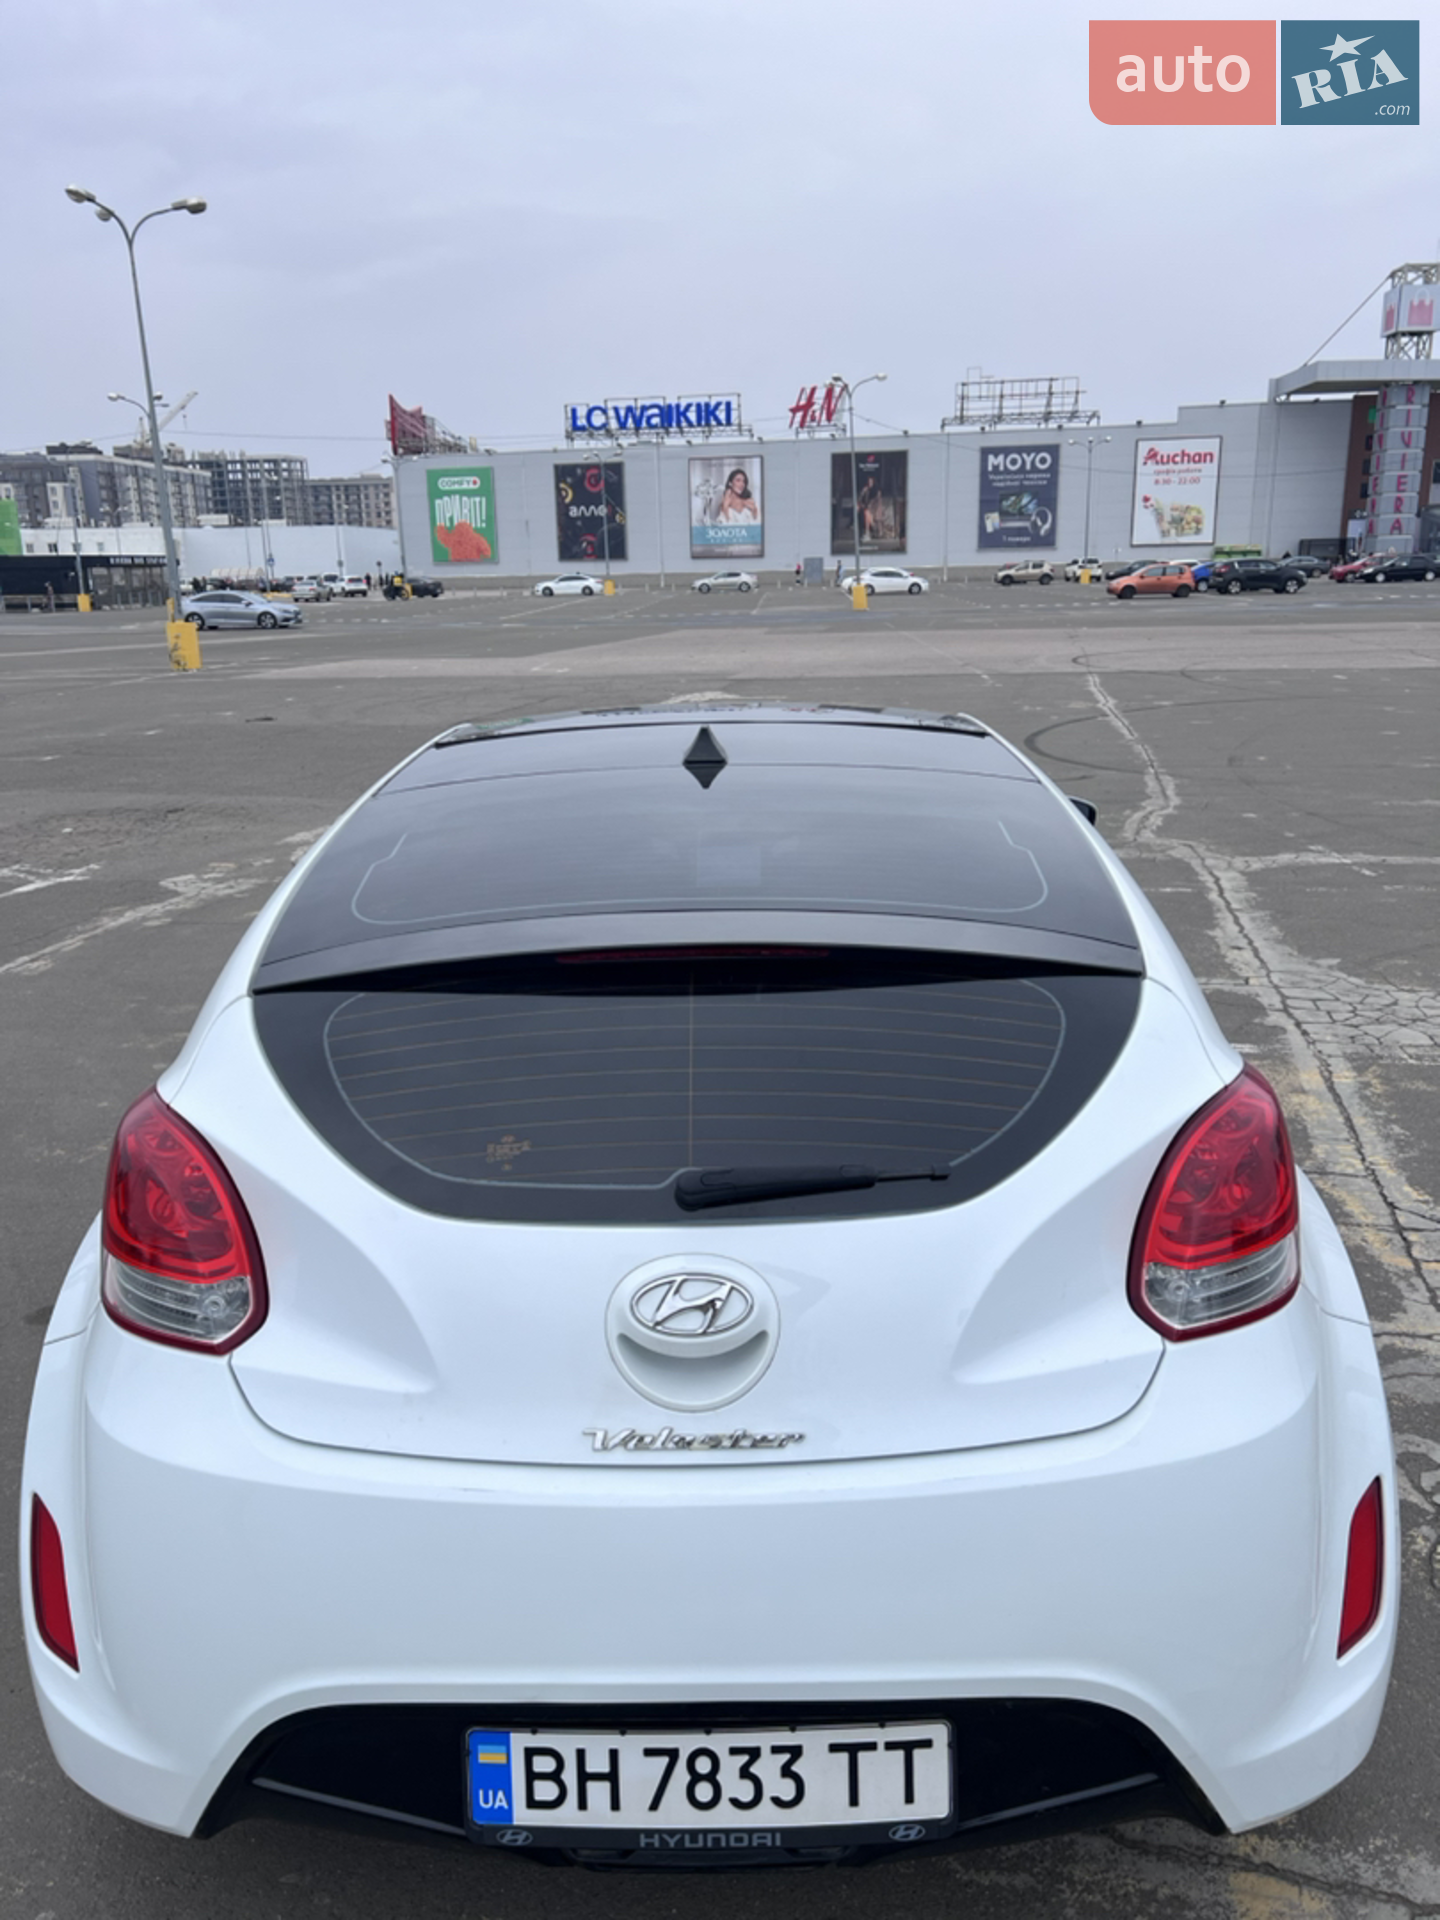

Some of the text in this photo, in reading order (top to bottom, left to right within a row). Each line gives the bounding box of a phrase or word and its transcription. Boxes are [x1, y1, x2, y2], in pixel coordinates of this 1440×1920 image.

[571, 405, 609, 431] LC
[988, 452, 1052, 471] MOYO
[1143, 447, 1214, 466] Auchan
[1389, 385, 1416, 535] RIVIERA
[440, 479, 472, 488] COMFY
[705, 527, 748, 538] ЗОЛОТА
[582, 1426, 806, 1451] Veloster
[523, 1738, 934, 1812] BH 7833 TT
[478, 1789, 509, 1811] UA
[639, 1831, 782, 1849] HYUNDAI
